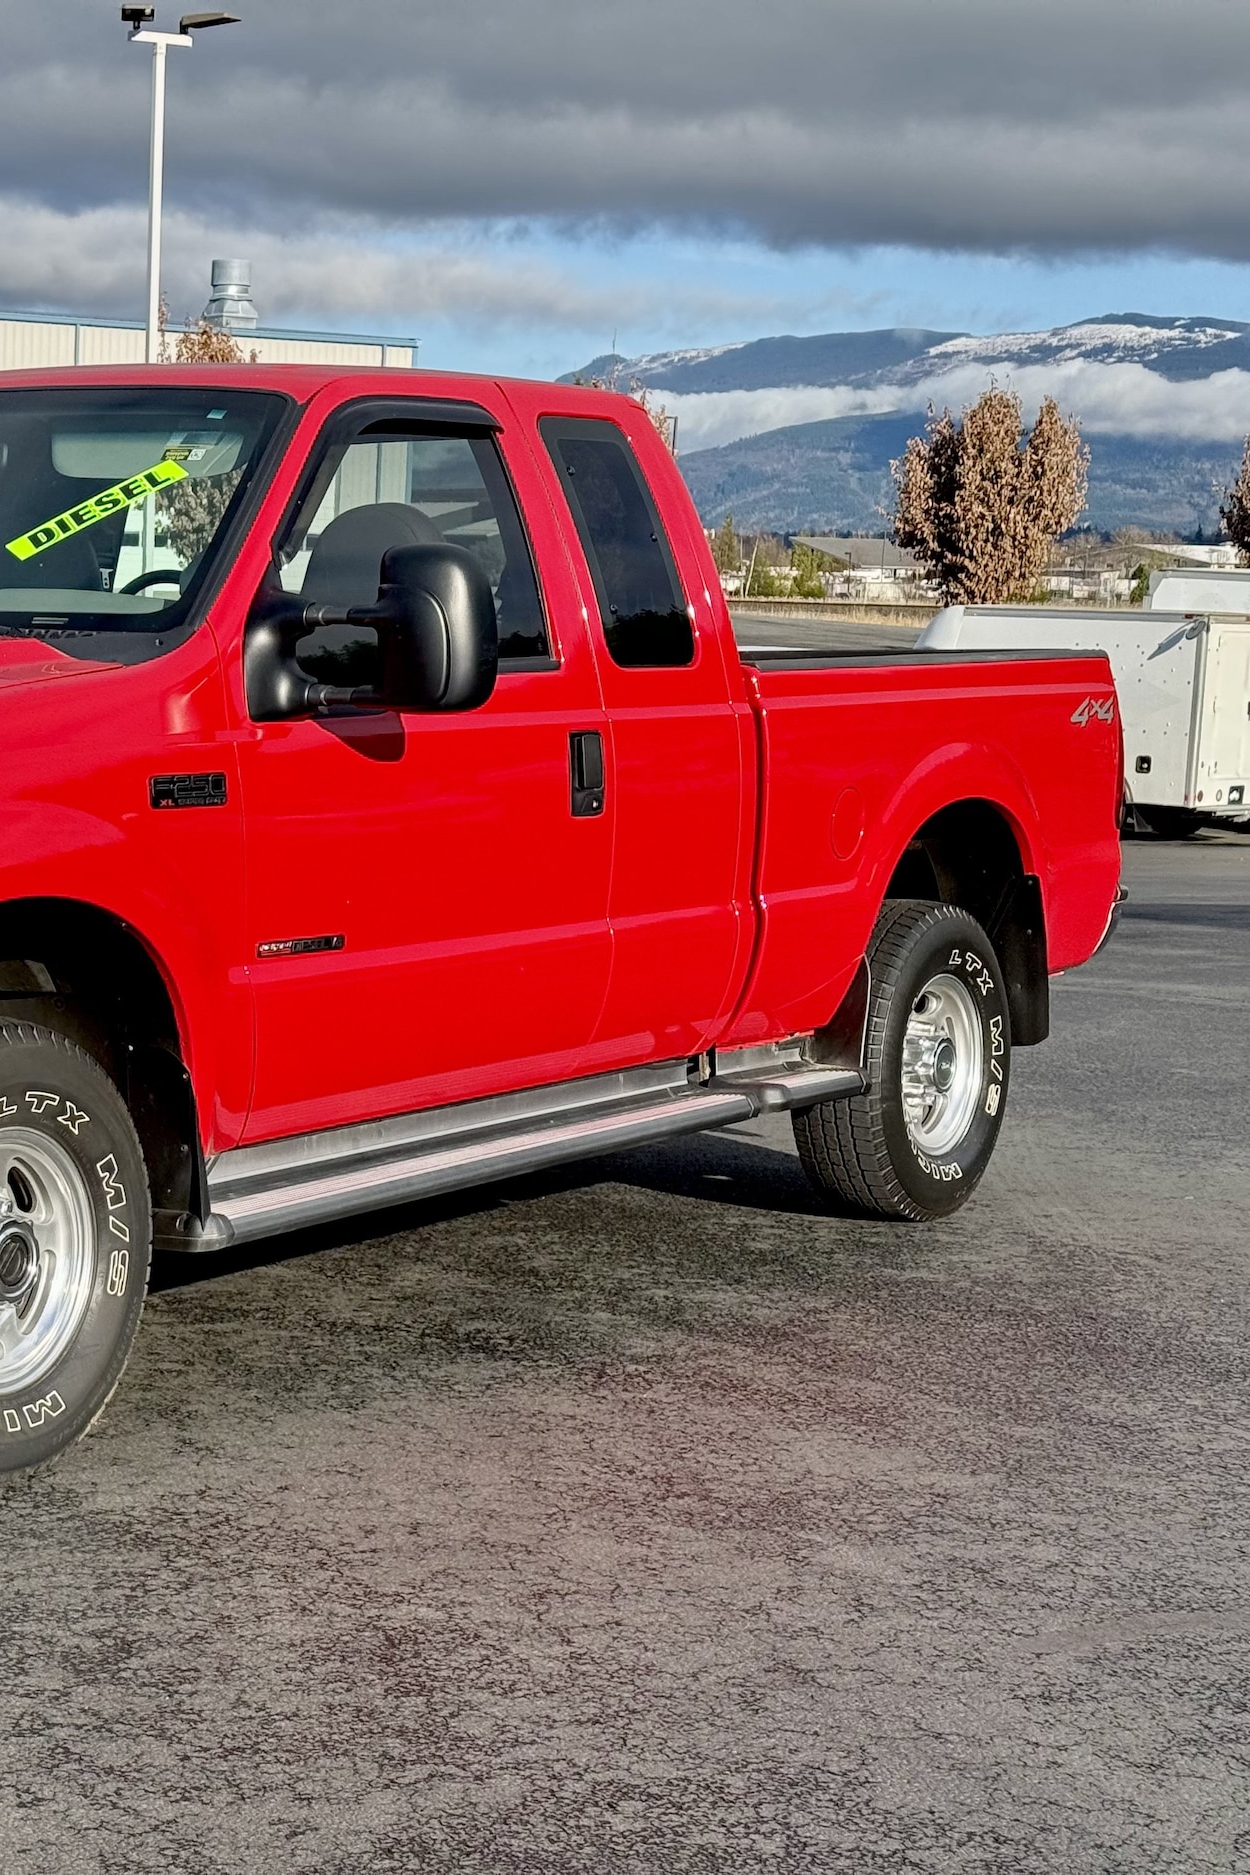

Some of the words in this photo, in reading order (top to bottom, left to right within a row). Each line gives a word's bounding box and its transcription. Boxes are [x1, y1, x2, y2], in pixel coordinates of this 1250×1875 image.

[27, 471, 174, 549] DIESEL
[159, 799, 175, 807] XL
[949, 949, 994, 996] LTX
[985, 1015, 1004, 1116] M/S
[95, 1153, 130, 1297] M/S
